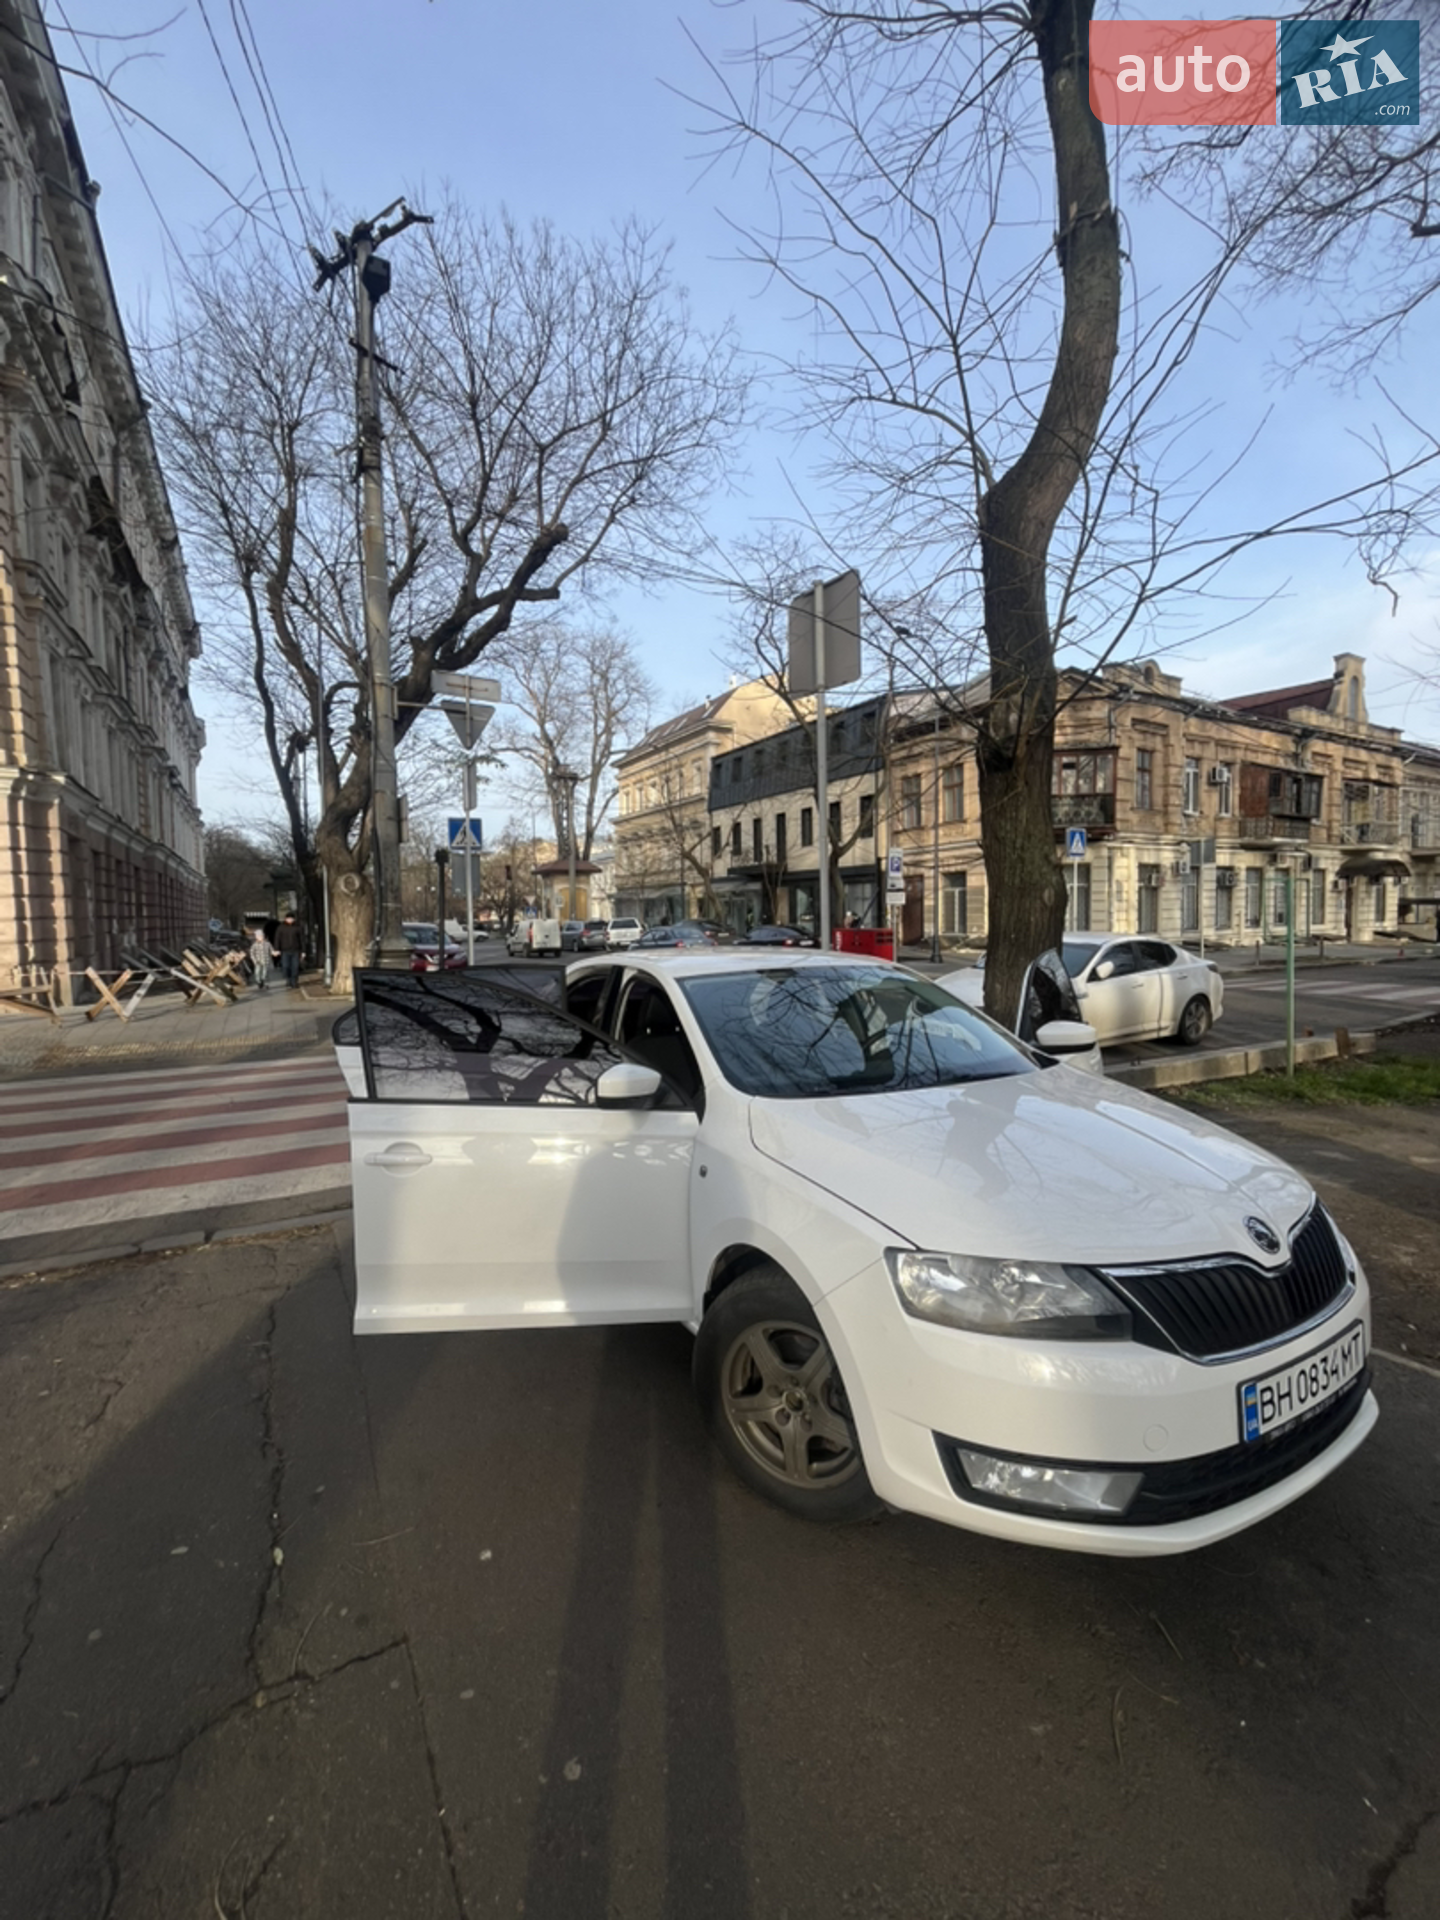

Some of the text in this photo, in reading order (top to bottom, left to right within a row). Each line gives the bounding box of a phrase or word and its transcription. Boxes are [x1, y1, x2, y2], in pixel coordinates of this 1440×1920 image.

[1260, 1375, 1293, 1425] BH
[1296, 1348, 1340, 1404] 0834
[1340, 1331, 1361, 1378] MT
